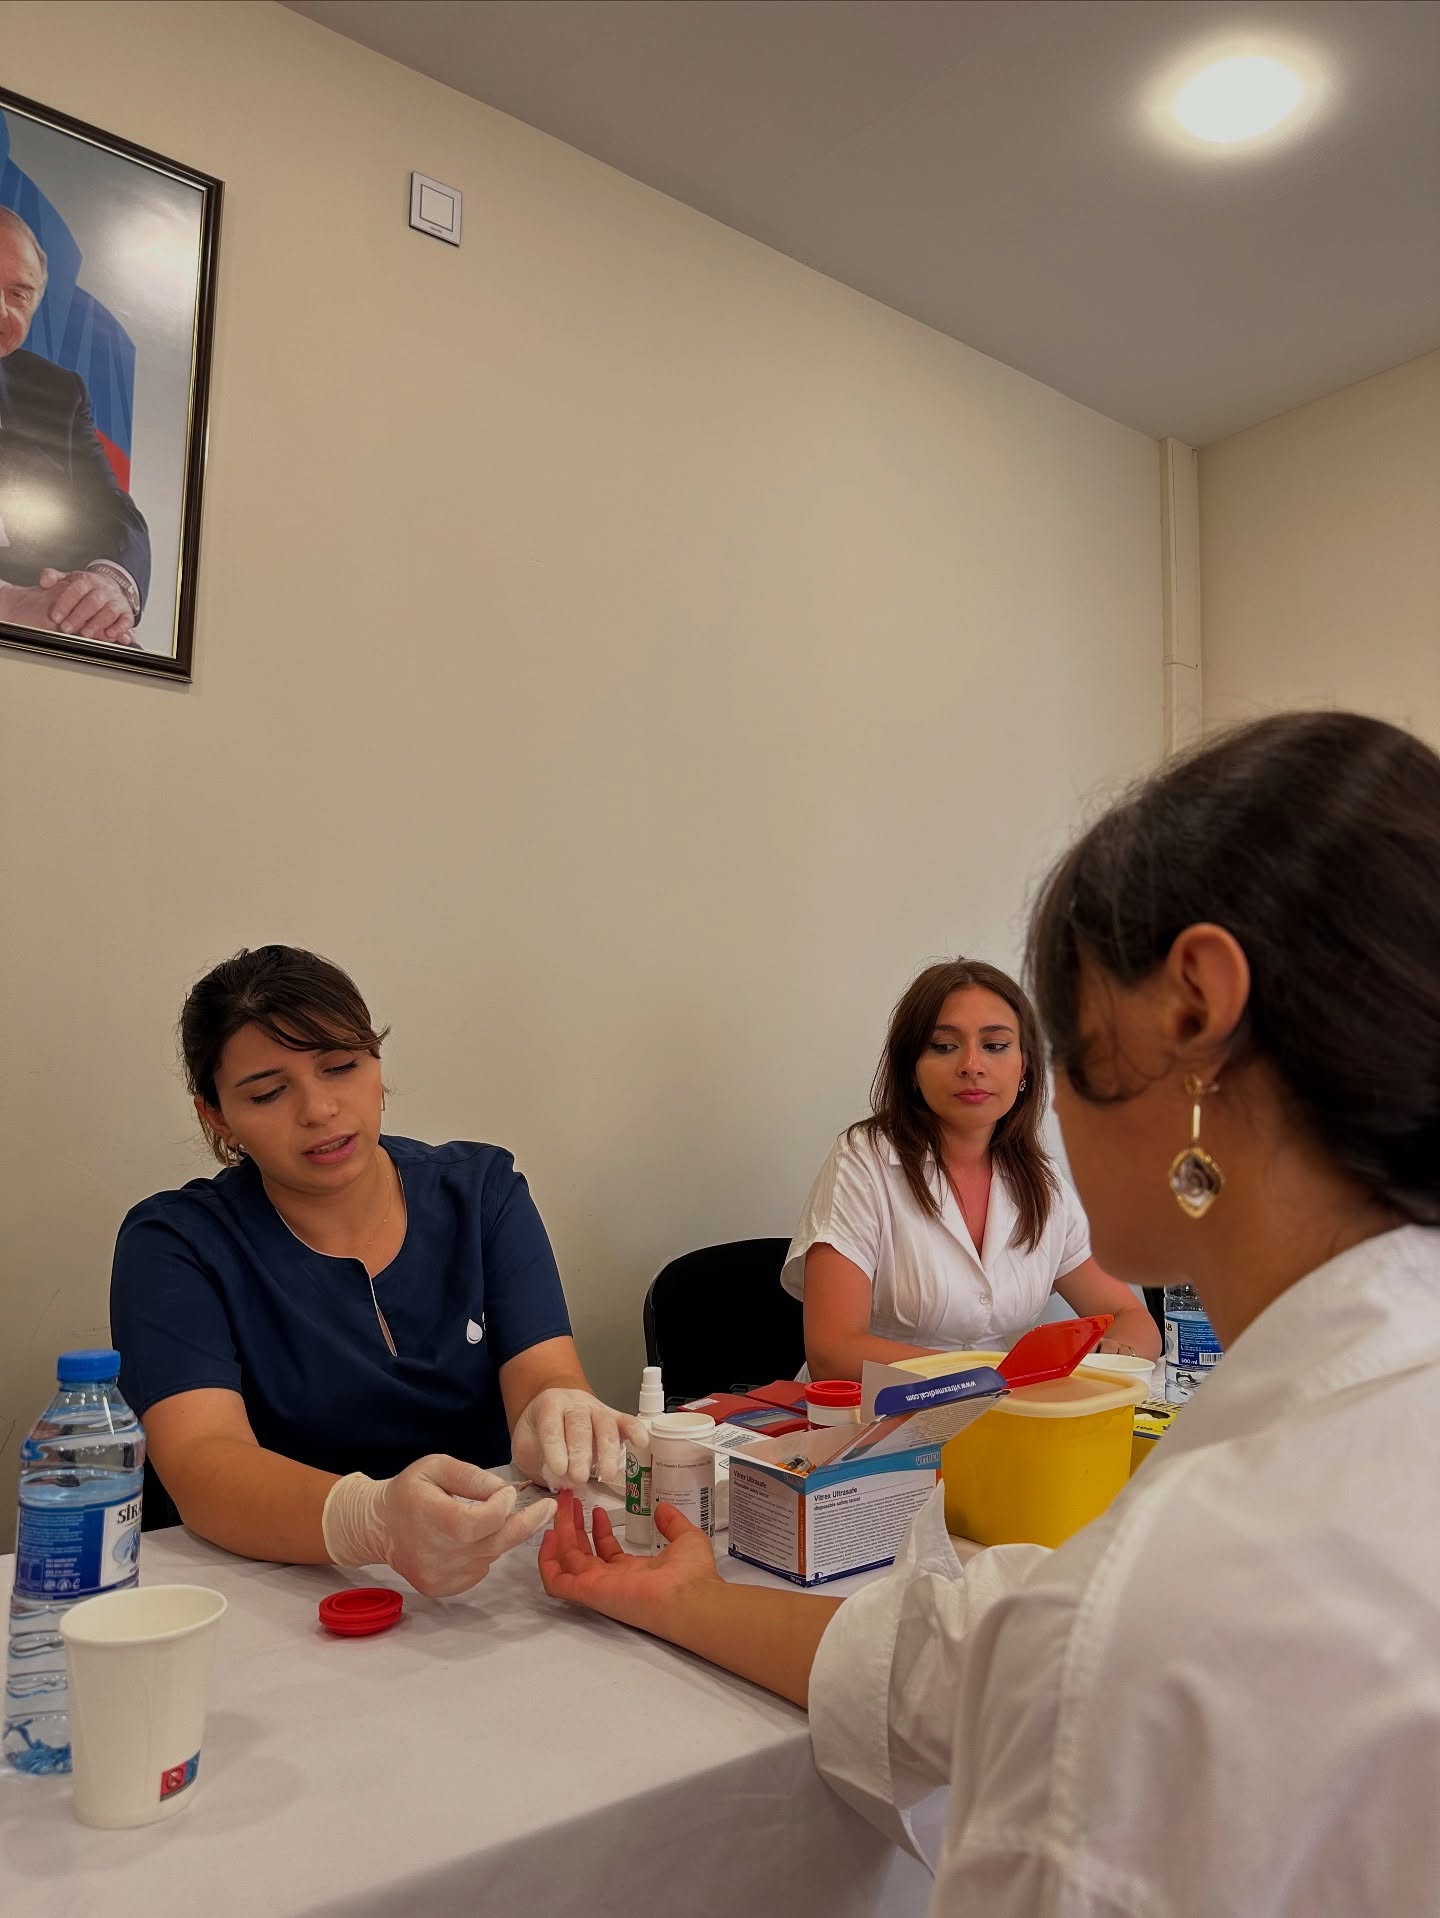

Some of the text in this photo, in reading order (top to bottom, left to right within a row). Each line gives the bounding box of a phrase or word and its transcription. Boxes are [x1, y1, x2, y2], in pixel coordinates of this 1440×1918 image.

[905, 1380, 977, 1402] www.vitrexmedical.com
[916, 1451, 941, 1465] VITREX
[814, 1486, 858, 1502] Vitrex Ultrasafe
